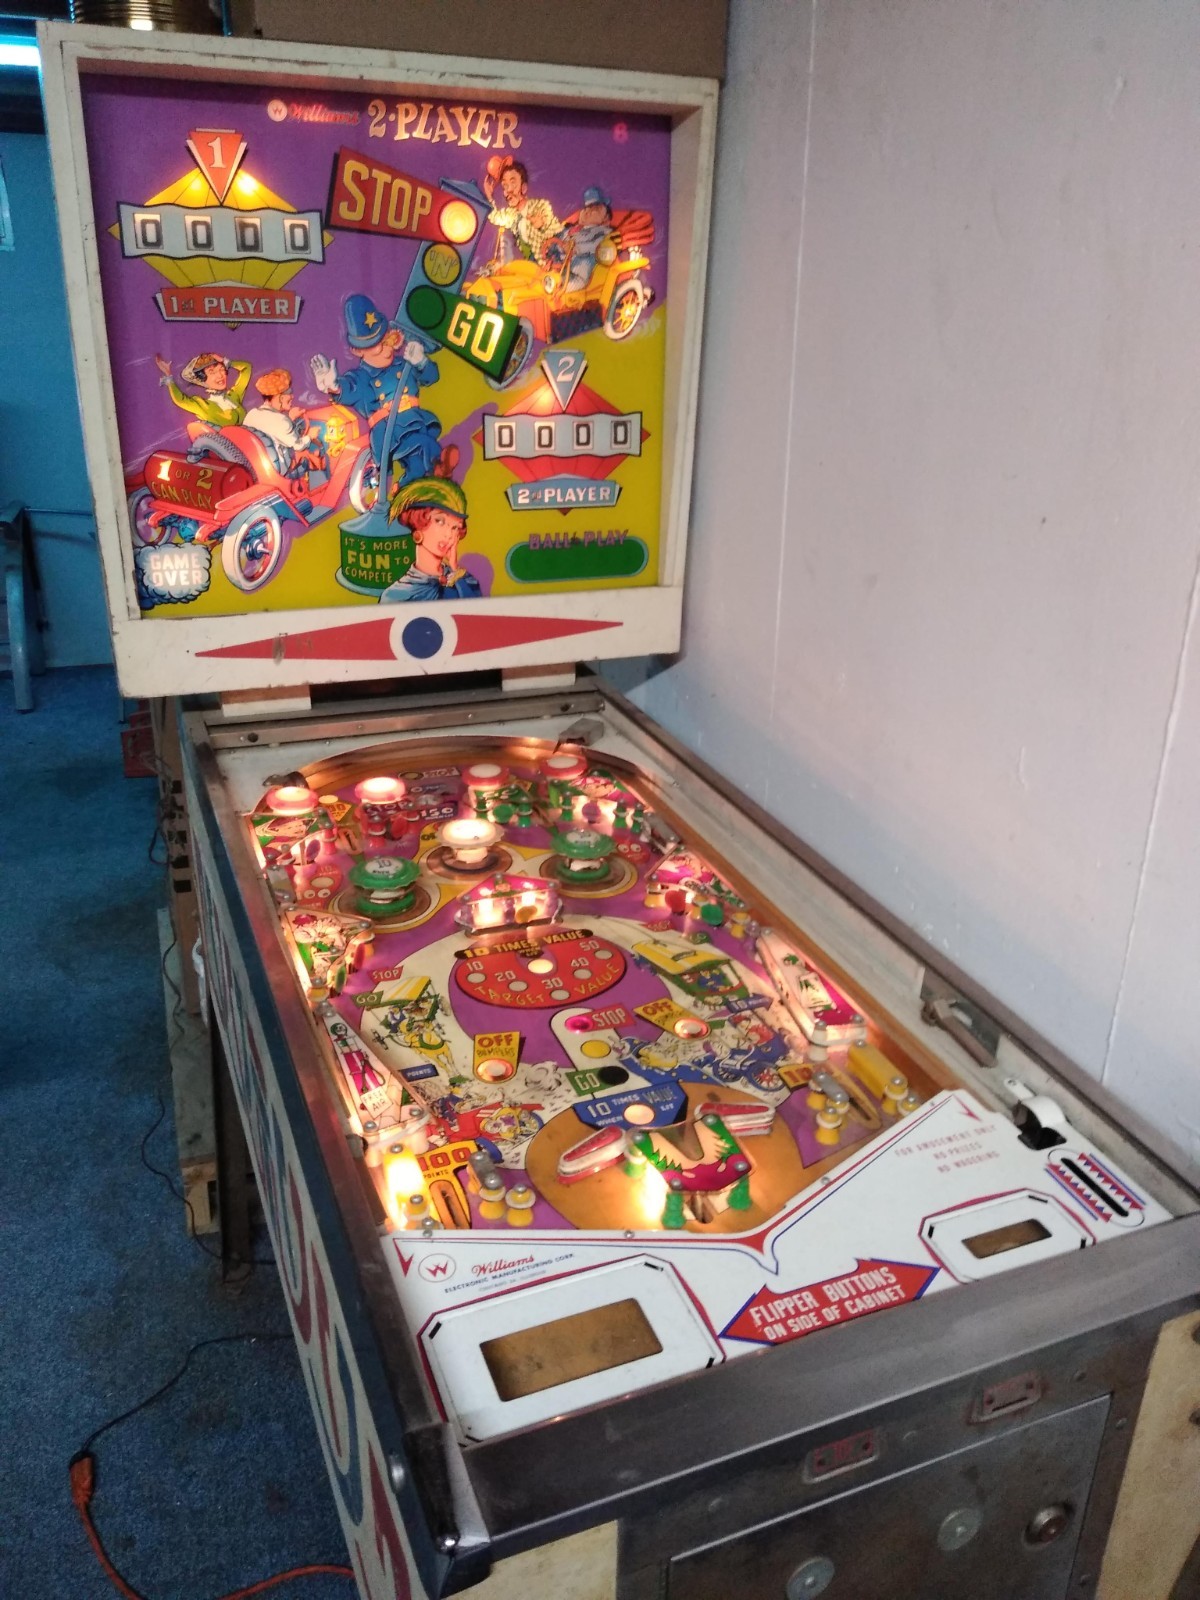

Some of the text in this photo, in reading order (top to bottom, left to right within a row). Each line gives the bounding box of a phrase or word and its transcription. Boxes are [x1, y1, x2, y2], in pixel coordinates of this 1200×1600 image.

[287, 102, 361, 125] Williams
[207, 136, 227, 169] 1
[339, 159, 433, 232] STOP
[204, 297, 289, 315] PLAYER
[447, 302, 504, 363] GO
[556, 356, 576, 382] 2
[157, 460, 213, 490] 1 OR 2
[151, 482, 213, 511] CAN PLAY
[544, 487, 611, 503] PLAYER
[344, 537, 408, 551] IT'S MORE
[529, 532, 570, 550] BALL
[583, 529, 629, 546] PLAY
[151, 552, 201, 571] GAME
[347, 550, 411, 570] FUN TO
[152, 569, 203, 587] OVER
[345, 566, 393, 583] COMPETE
[494, 940, 538, 954] TIMES
[542, 930, 585, 945] VALUE
[578, 940, 600, 952] 50
[466, 961, 485, 971] 10
[570, 957, 589, 968] 40
[372, 968, 400, 982] STOP
[474, 963, 620, 1006] TARGET VALUE
[495, 970, 516, 982] 20
[541, 977, 564, 989] 30
[356, 993, 378, 1004] GO
[592, 1007, 627, 1028] STOP
[478, 1034, 513, 1049] OFF
[574, 1073, 602, 1092] GO
[587, 1101, 611, 1119] 10
[611, 1094, 640, 1106] TIMES
[916, 1131, 971, 1151] AMUSEMENT
[417, 1147, 473, 1172] 100
[952, 1151, 1000, 1170] WAGERING
[472, 1254, 535, 1277] Williams
[445, 1276, 489, 1294] ELECTRONIC
[491, 1260, 554, 1281] MANUFACTURING
[749, 1266, 897, 1327] FLIPPER BUTTONS
[763, 1284, 906, 1341] ON SIDE OF CABINET
